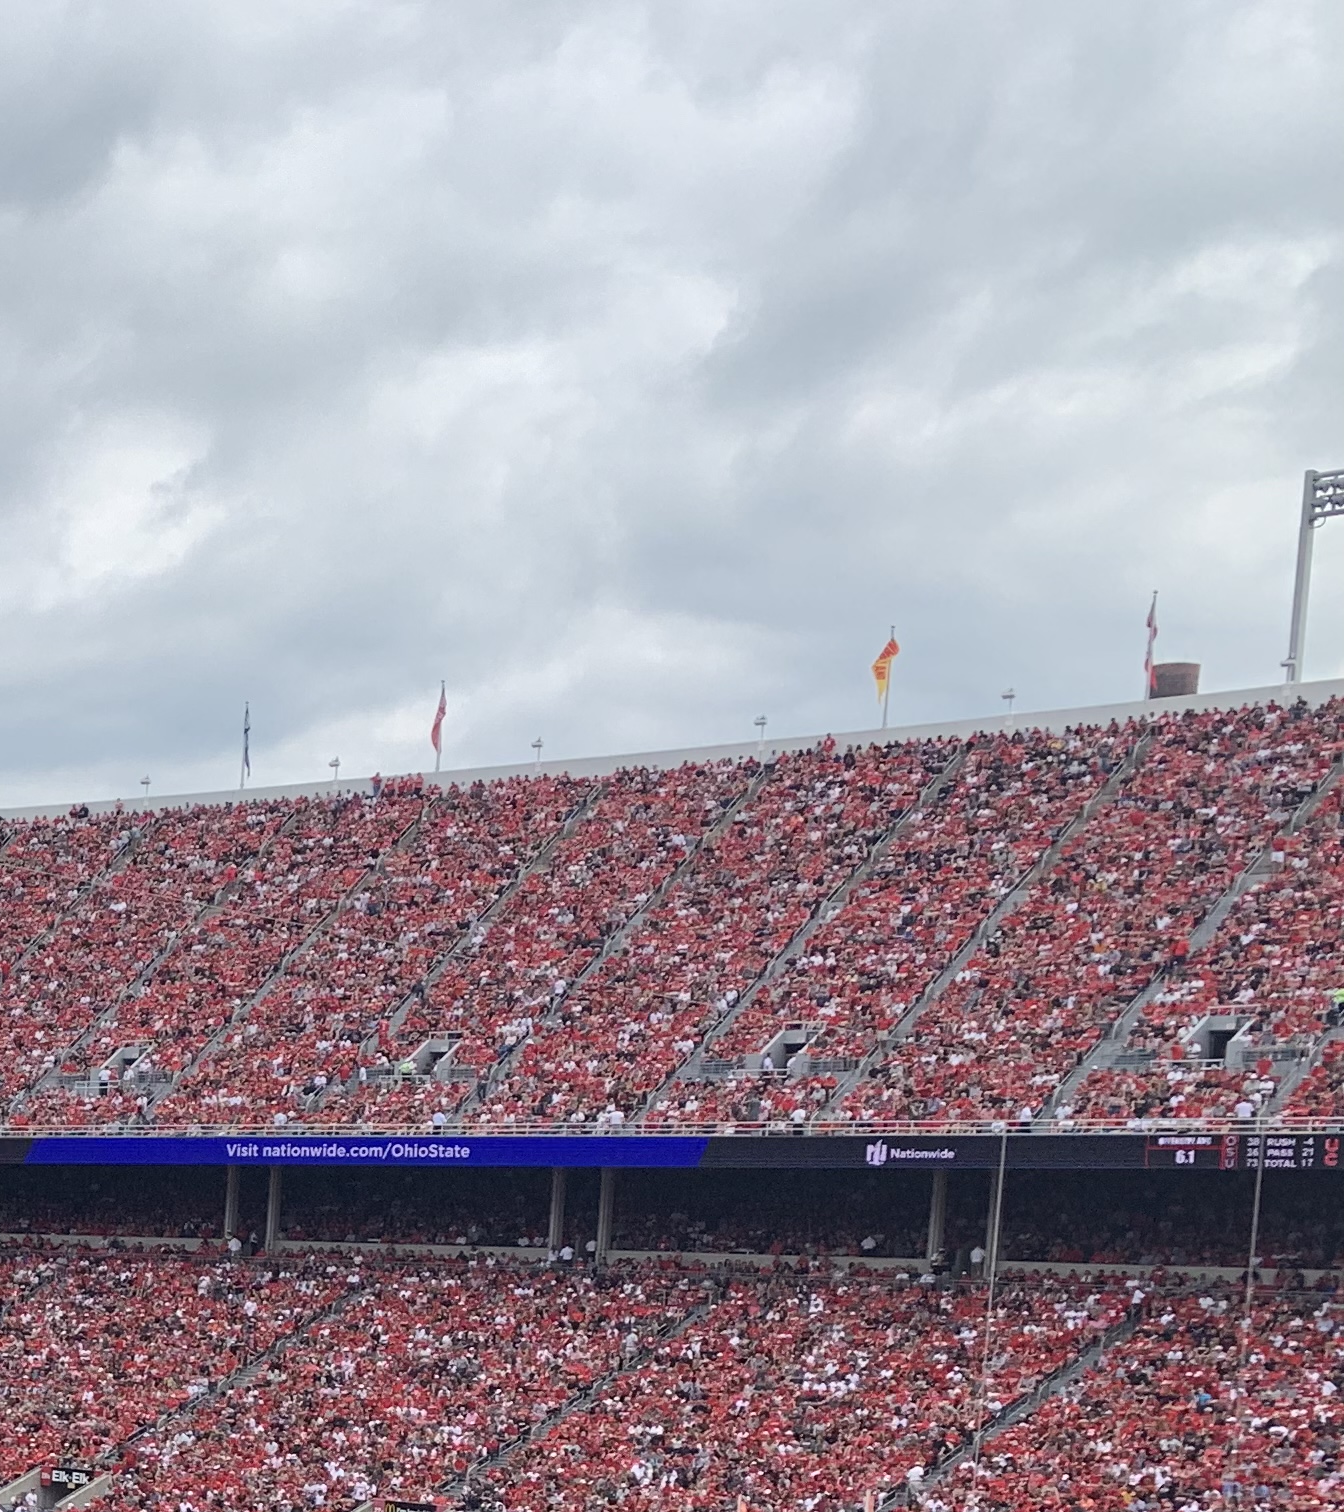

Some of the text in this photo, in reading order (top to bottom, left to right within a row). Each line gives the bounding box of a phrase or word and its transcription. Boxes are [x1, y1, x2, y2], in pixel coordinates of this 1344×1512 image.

[1266, 1137, 1297, 1147] RUSH
[226, 1142, 471, 1160] Visit nationwide.com/OhioState
[890, 1148, 956, 1159] Nationwide
[1266, 1148, 1294, 1157] PASS
[1175, 1150, 1196, 1164] 6.1
[1264, 1159, 1298, 1169] TOTAL
